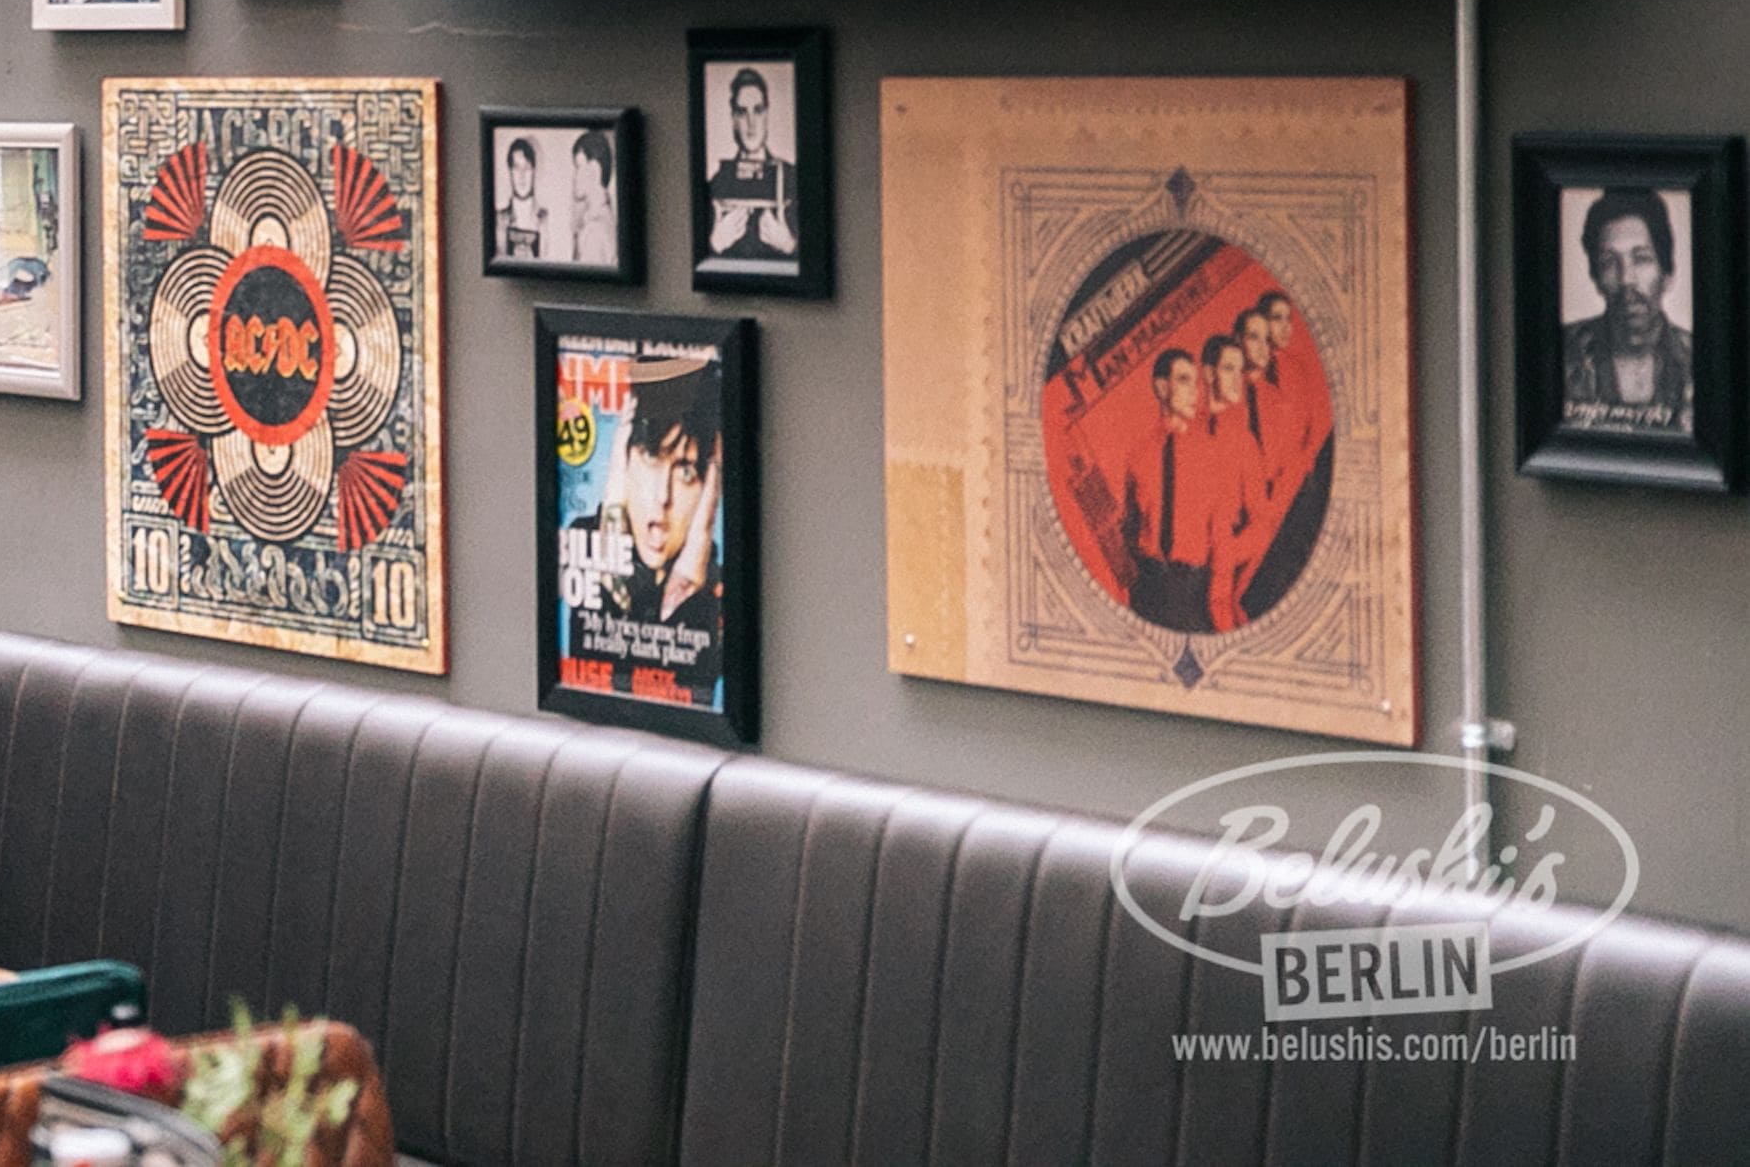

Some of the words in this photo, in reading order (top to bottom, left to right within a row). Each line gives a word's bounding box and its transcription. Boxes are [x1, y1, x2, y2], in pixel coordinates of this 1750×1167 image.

[224, 313, 320, 381] AC/DC
[558, 414, 591, 449] 49
[132, 527, 170, 595] 10
[372, 559, 417, 630] 10
[559, 567, 603, 610] OE
